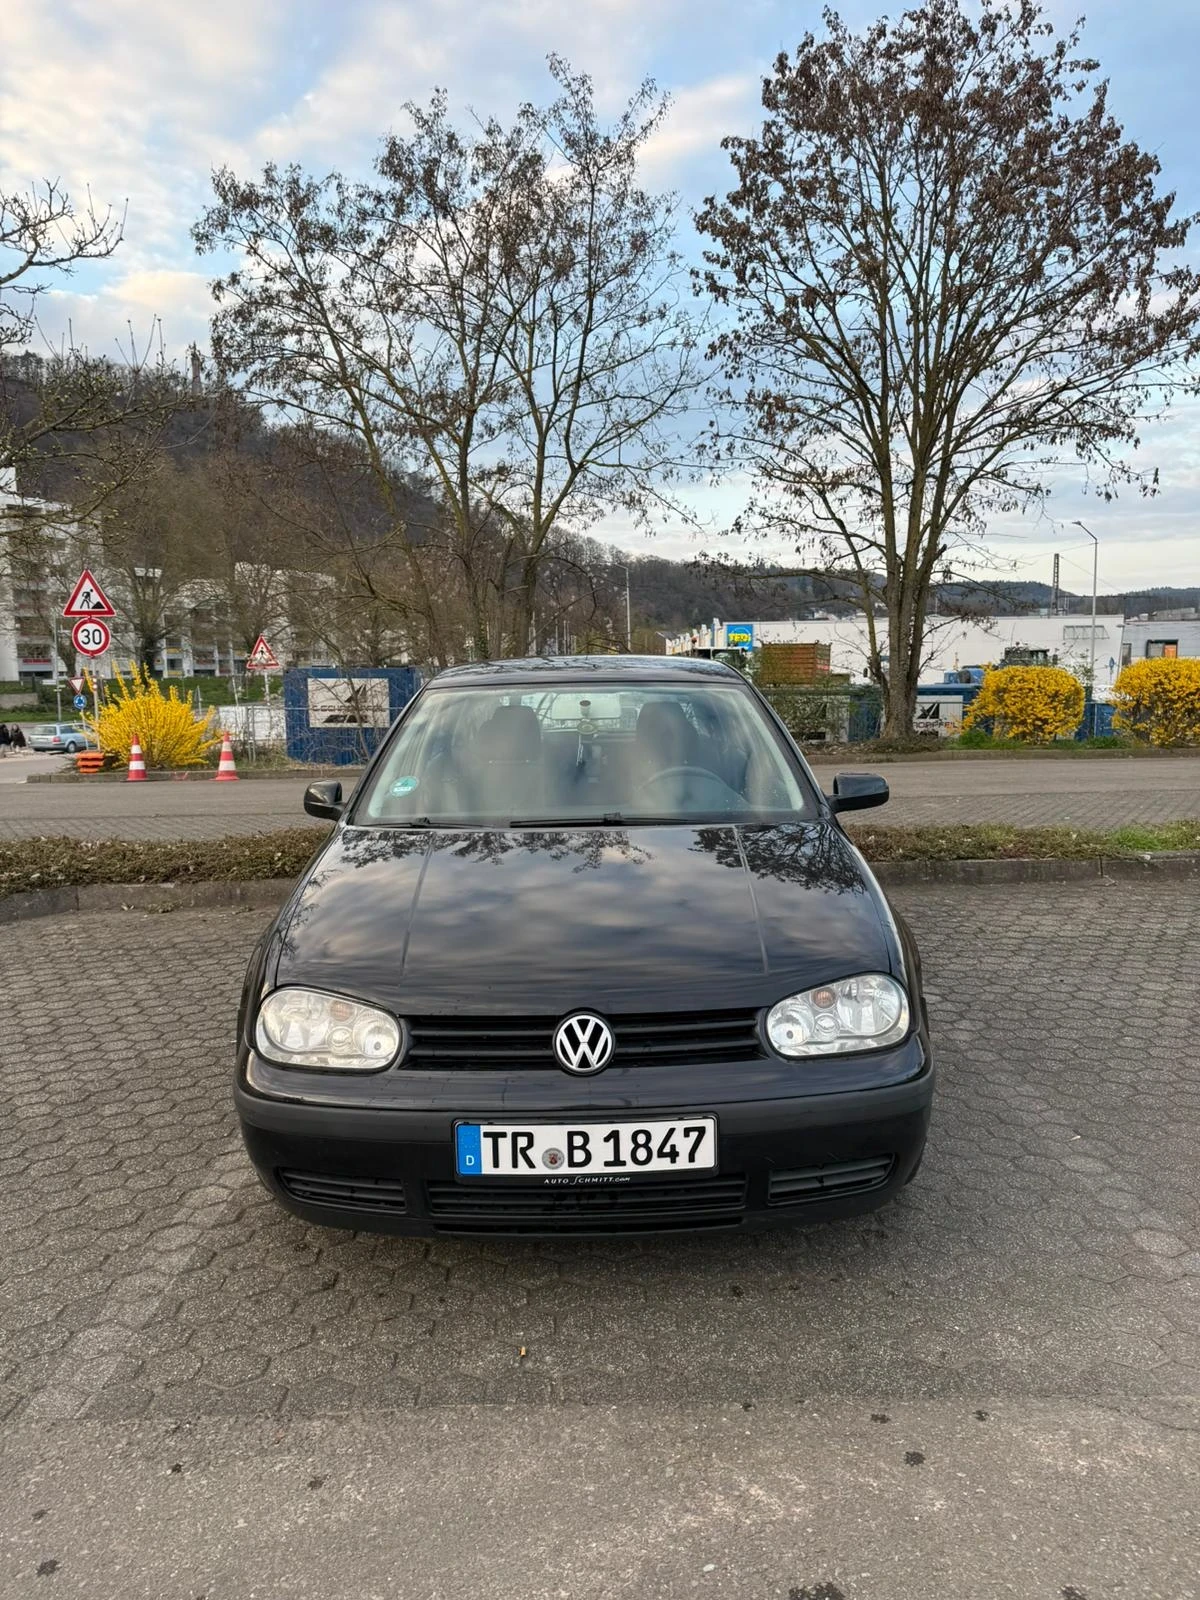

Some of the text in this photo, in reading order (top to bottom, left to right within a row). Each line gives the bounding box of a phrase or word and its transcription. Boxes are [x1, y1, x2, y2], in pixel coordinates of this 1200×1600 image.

[81, 629, 102, 645] 30
[556, 1014, 613, 1073] VW
[465, 1155, 475, 1166] D
[483, 1126, 706, 1169] TR B 1847
